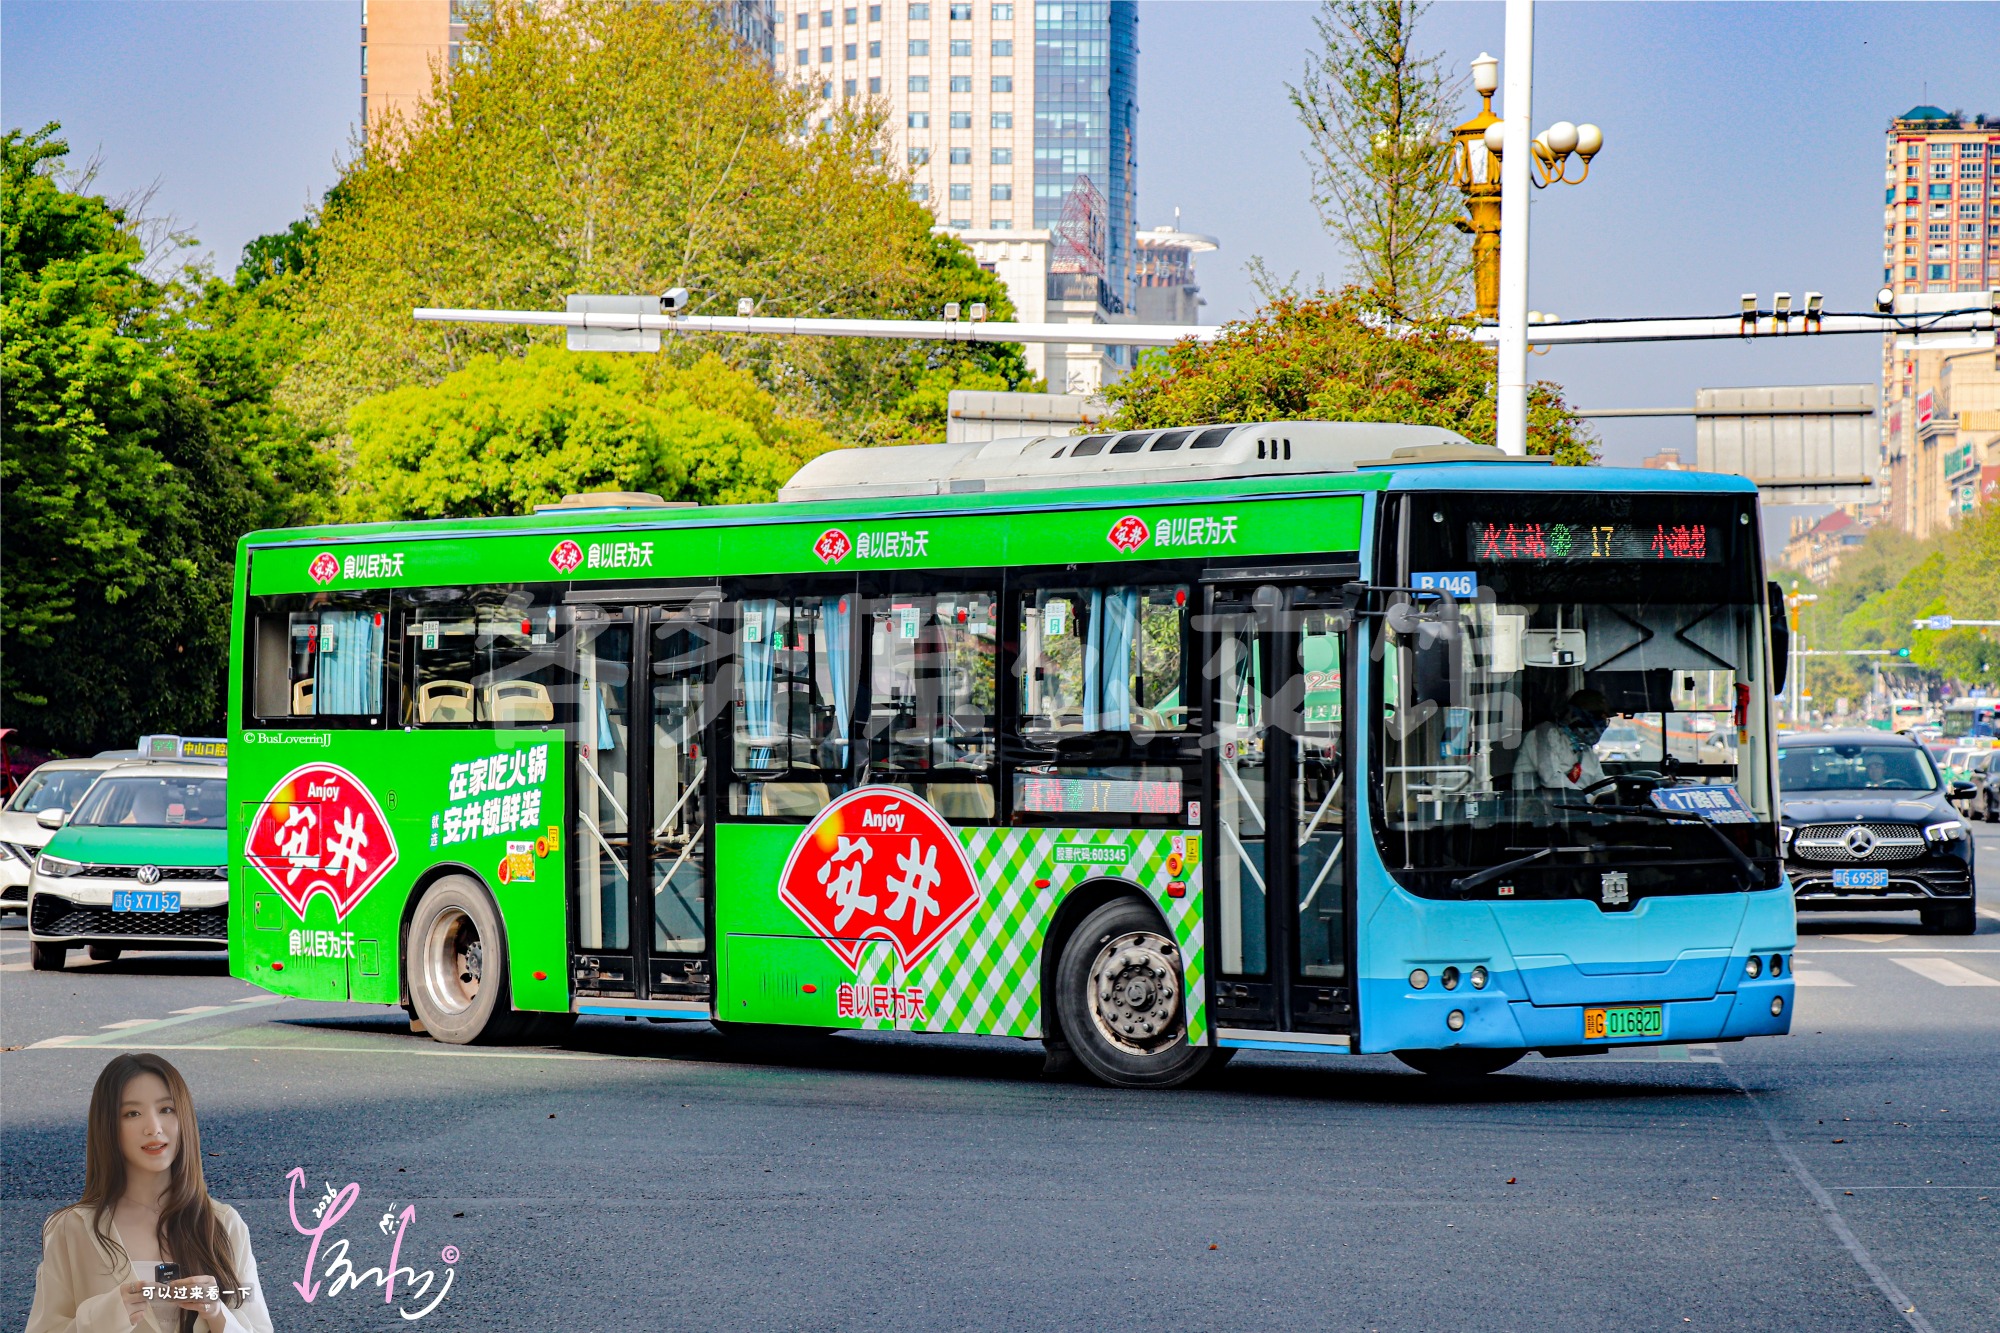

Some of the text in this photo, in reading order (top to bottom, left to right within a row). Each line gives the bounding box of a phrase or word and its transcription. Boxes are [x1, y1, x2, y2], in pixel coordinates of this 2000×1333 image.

[856, 531, 929, 558] 食以民为天
[1155, 516, 1238, 547] 食以民为天
[1482, 523, 1547, 558] 火车站
[1591, 526, 1614, 557] 17
[343, 553, 405, 579] 食以民为天
[587, 542, 654, 568] 食以民为天
[184, 741, 228, 757] 中山口腔
[448, 744, 548, 801] 在家吃火锅
[307, 776, 340, 802] Anjoy
[1091, 782, 1112, 812] 17
[442, 788, 542, 845] 安井锁鲜装
[862, 801, 905, 832] Anjoy
[274, 805, 368, 889] 安井
[1056, 846, 1127, 862] 股票代码:603345
[817, 836, 941, 936] 安井
[289, 929, 355, 959] 食以民为天
[837, 984, 925, 1020] 食以民为天
